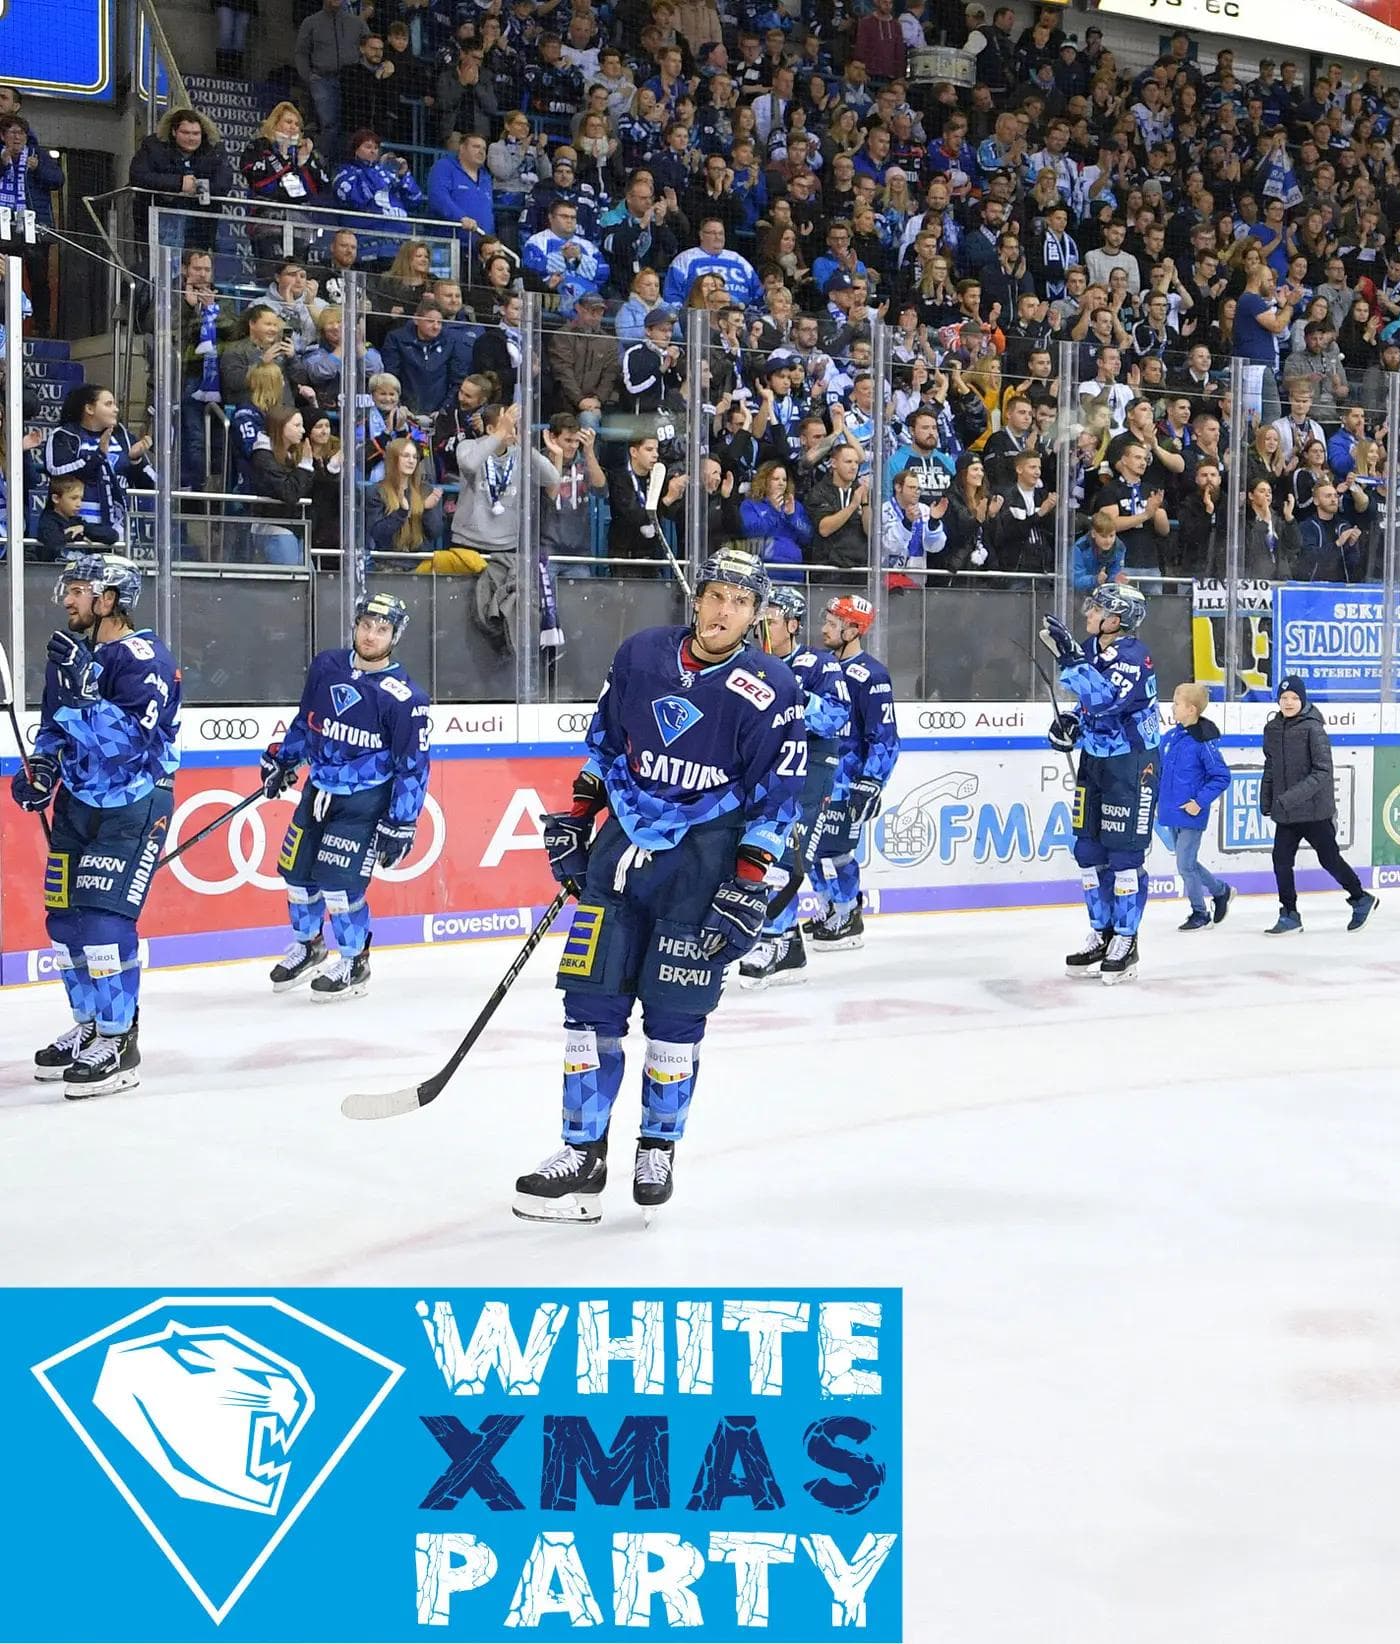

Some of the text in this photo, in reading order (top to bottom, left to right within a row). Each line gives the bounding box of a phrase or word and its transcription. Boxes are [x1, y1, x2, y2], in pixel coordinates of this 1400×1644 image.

[239, 421, 256, 439] 15
[730, 675, 771, 702] DEL
[445, 716, 504, 733] Audi
[974, 712, 1025, 728] Audi
[1322, 711, 1356, 726] udi
[322, 717, 382, 749] SATURN
[639, 750, 729, 792] SATURN
[776, 740, 808, 777] 22
[127, 840, 160, 906] SATURN
[432, 912, 521, 937] covestro
